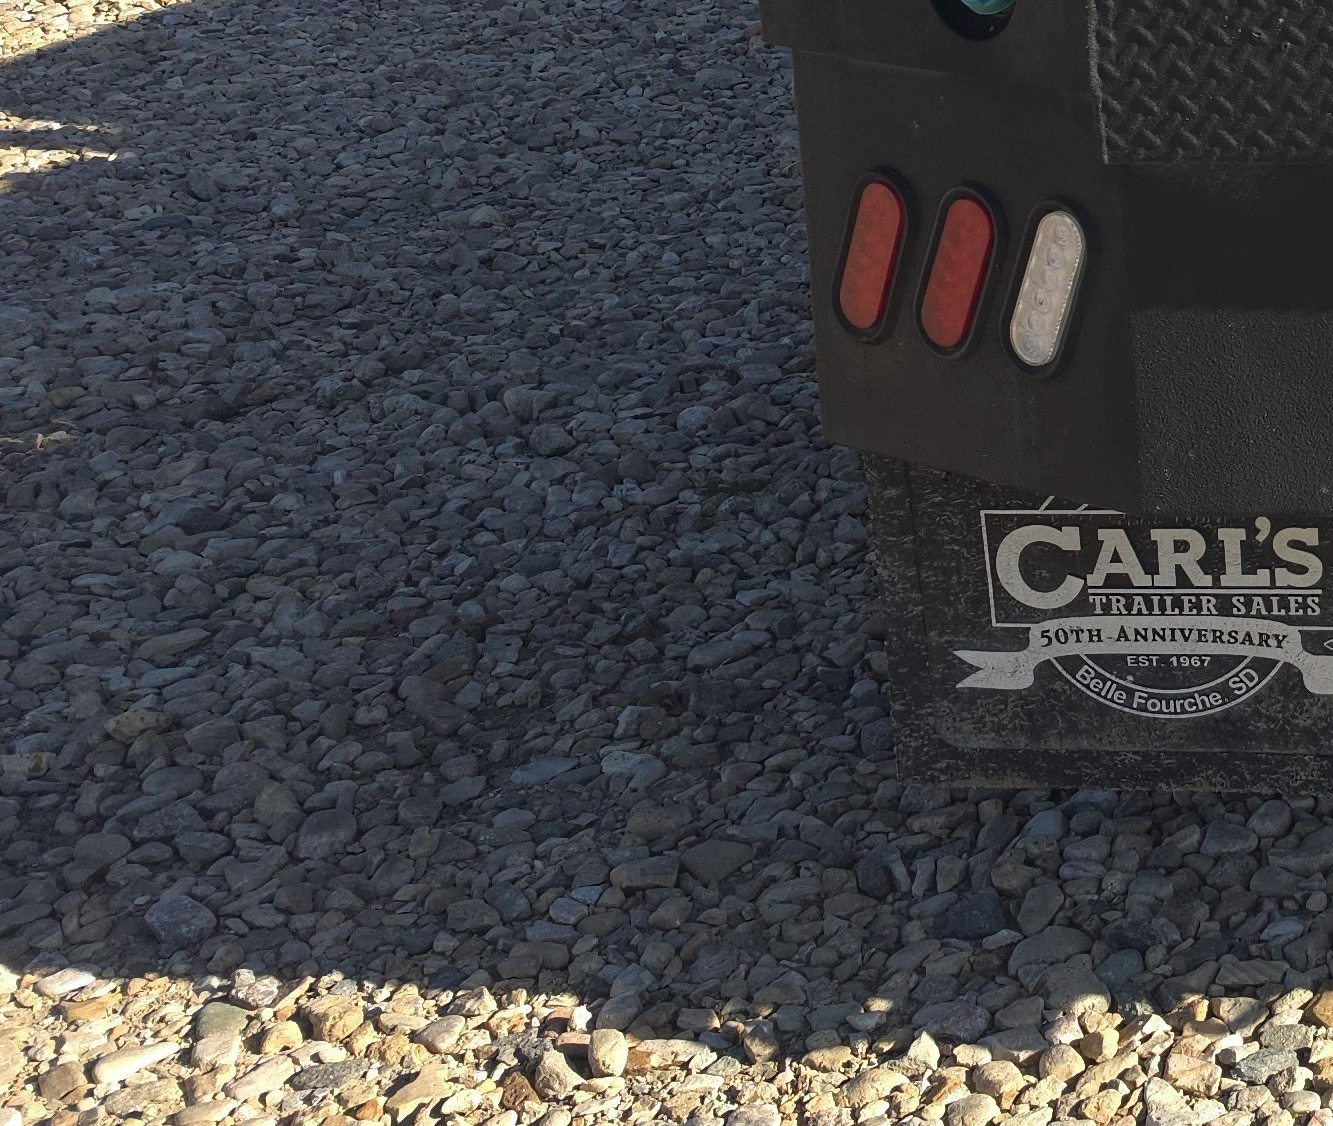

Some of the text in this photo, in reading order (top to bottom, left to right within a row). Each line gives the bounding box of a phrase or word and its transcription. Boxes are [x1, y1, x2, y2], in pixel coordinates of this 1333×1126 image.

[996, 516, 1324, 610] CARL'S
[1089, 595, 1322, 617] TRAILER SALES
[1039, 624, 1289, 650] 50TH ANNIVERSARY
[1170, 655, 1212, 668] 1967
[1074, 663, 1128, 705] Belle
[1228, 667, 1261, 697] SD
